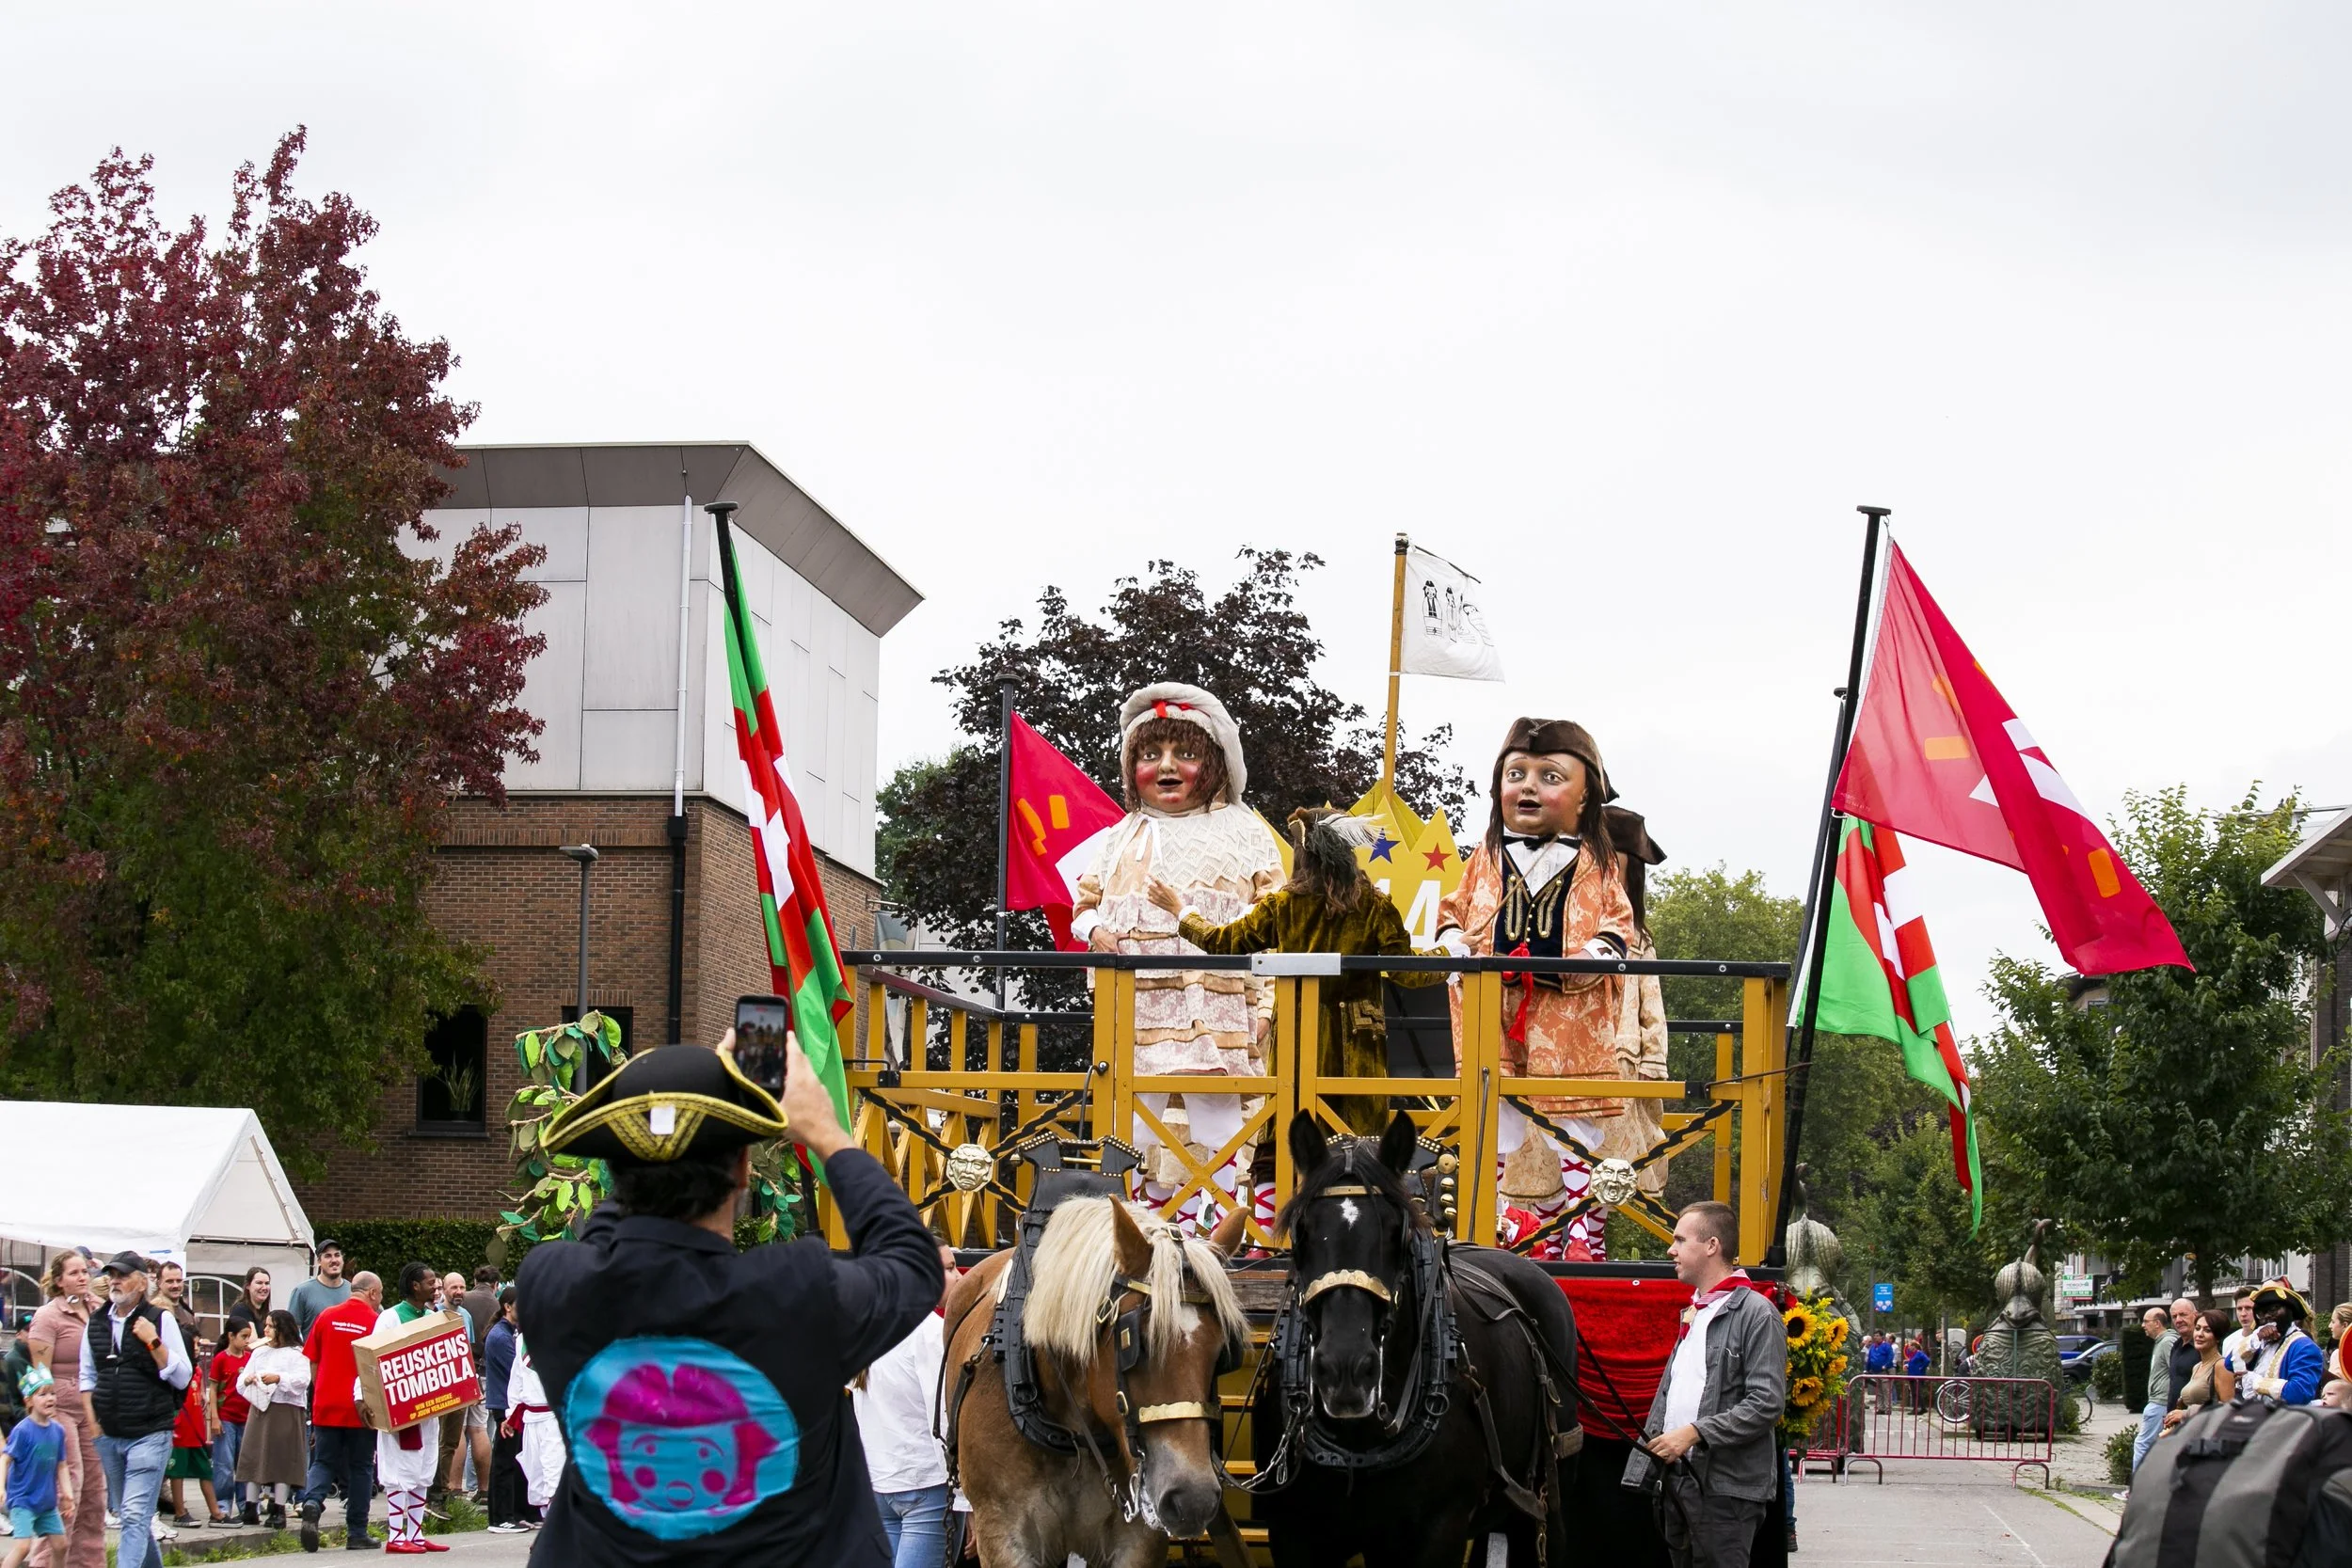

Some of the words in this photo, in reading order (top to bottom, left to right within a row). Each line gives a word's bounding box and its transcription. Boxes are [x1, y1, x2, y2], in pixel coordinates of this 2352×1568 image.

[379, 1333, 469, 1384] REUSKENS
[384, 1356, 474, 1405] TOMBOLA
[415, 1402, 425, 1411] WIN
